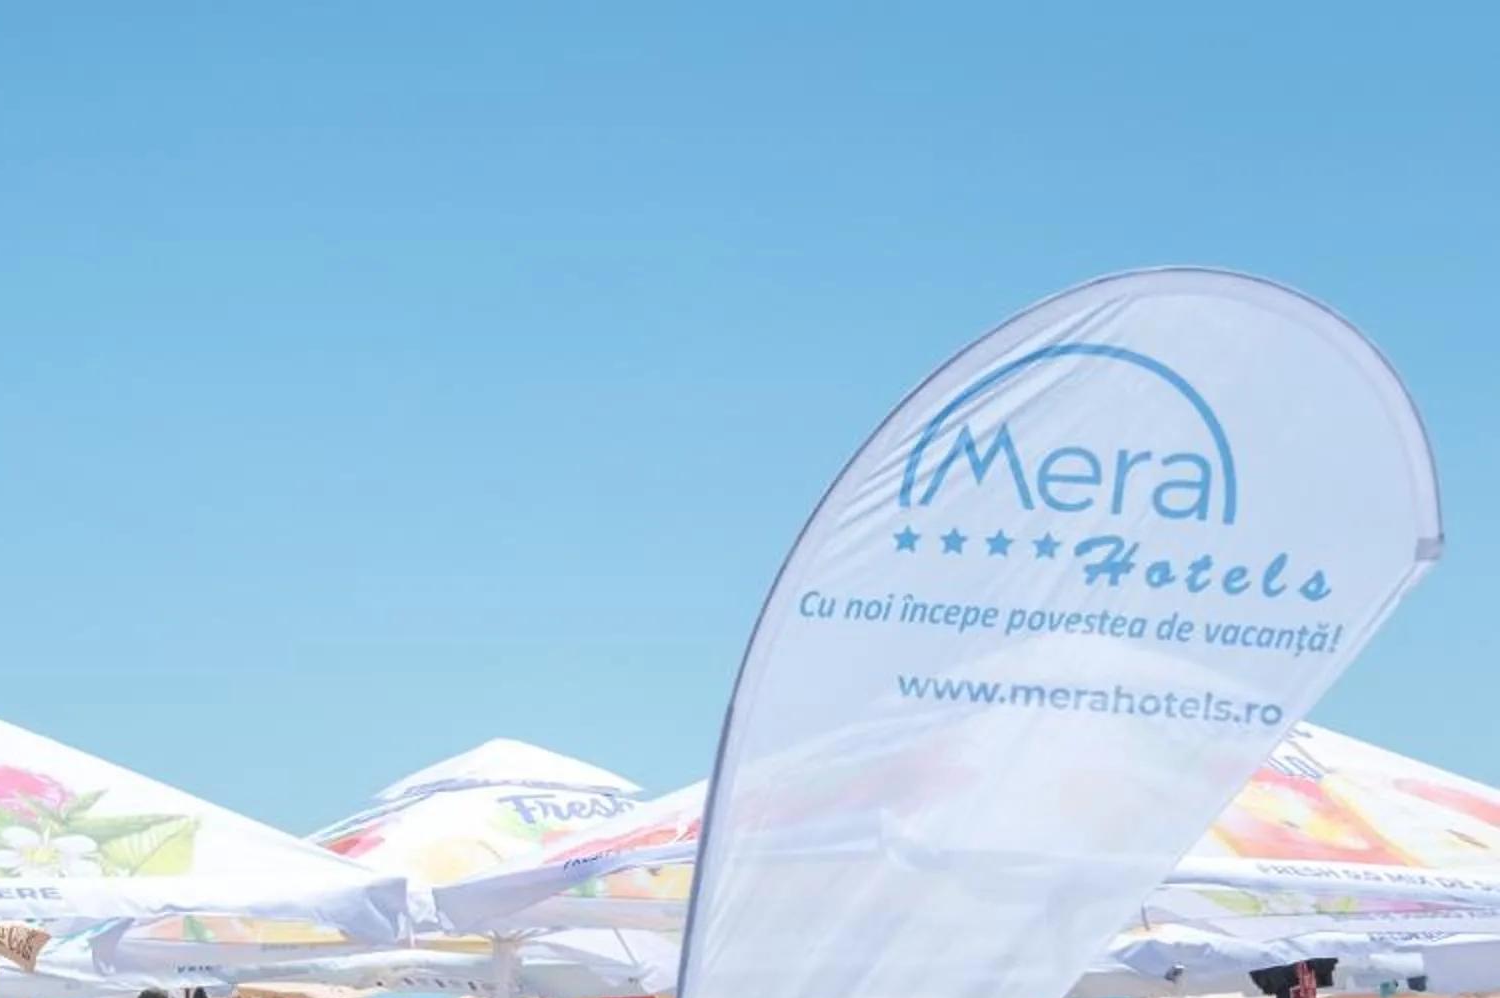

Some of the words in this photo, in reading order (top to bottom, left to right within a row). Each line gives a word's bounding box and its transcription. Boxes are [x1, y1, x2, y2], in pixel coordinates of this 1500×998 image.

[917, 421, 1213, 521] Mera
[1073, 534, 1333, 602] Hotels
[799, 590, 836, 619] Cu
[844, 593, 895, 621] noi
[900, 593, 999, 634] începe
[1004, 607, 1148, 639] povestea
[1156, 612, 1195, 643] de
[1204, 621, 1344, 657] vacanță!
[897, 673, 1283, 726] www.merahotels.ro
[496, 793, 635, 825] Fresh
